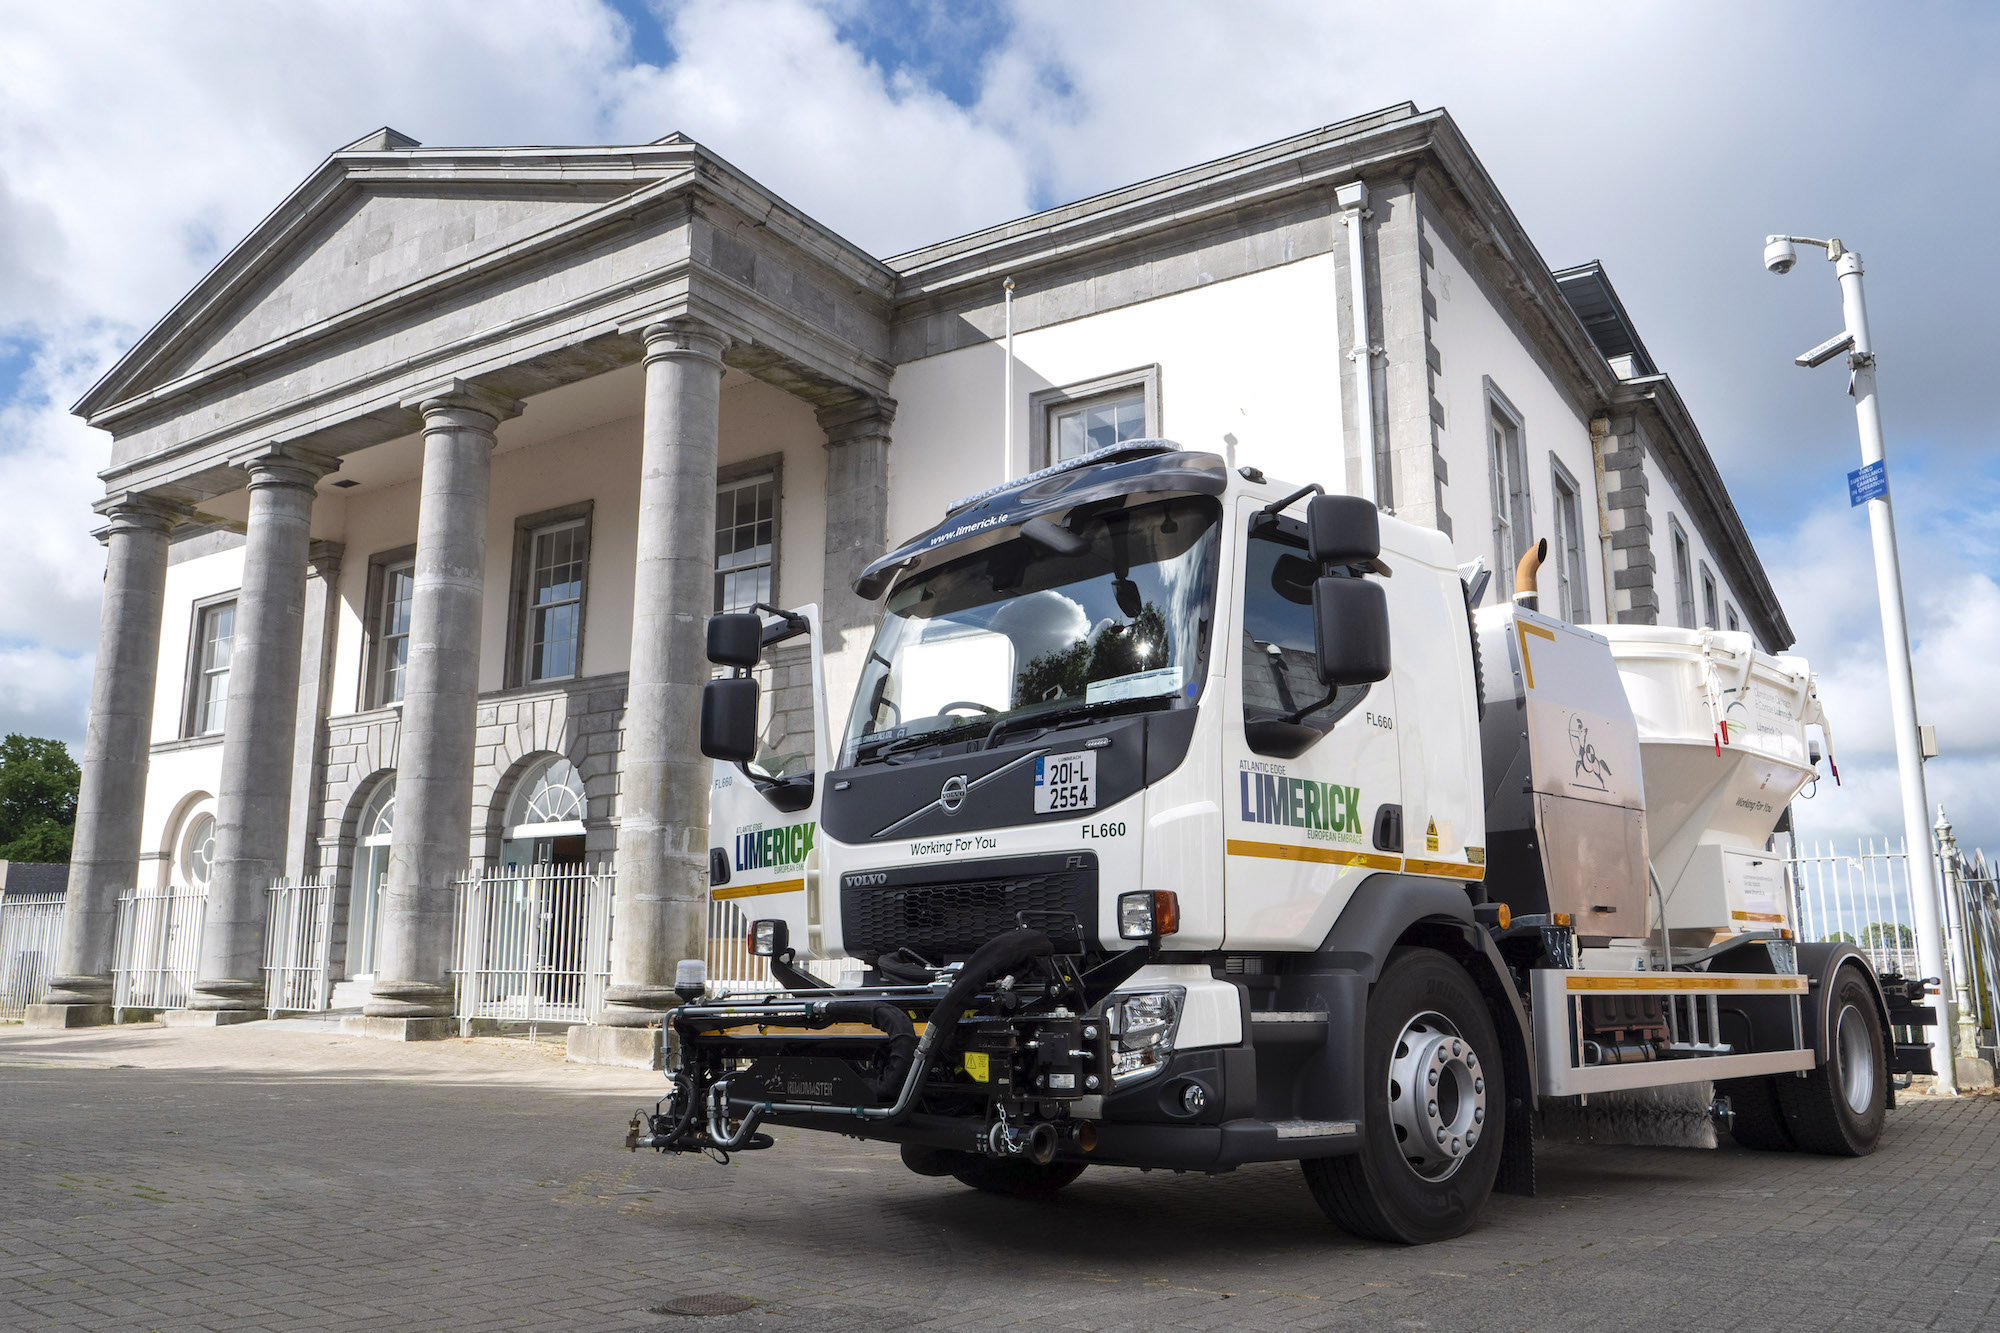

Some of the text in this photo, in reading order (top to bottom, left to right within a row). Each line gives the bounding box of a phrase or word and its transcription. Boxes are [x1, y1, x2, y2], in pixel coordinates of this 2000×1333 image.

[1856, 475, 1878, 488] CAMERAS
[930, 513, 1009, 546] www.limerick.ie
[1366, 712, 1393, 730] FL660
[1050, 761, 1089, 786] 201-L
[1239, 759, 1286, 775] ATLANTIC EDGE
[715, 776, 733, 789] FL660
[1035, 774, 1044, 782] IRL
[942, 791, 965, 799] VOLVO
[1050, 784, 1088, 809] 2554
[1240, 771, 1363, 834] LIMERICK
[1735, 796, 1774, 813] Working For You
[736, 822, 763, 834] ATLANTIC EDGE
[1082, 822, 1126, 839] FL660
[1307, 829, 1363, 845] EUROPEAN EMBRACE
[736, 821, 816, 872] LIMERICK
[910, 836, 997, 856] Working For You
[774, 863, 795, 875] EUROPEAN
[1066, 855, 1088, 869] FL
[845, 873, 887, 887] VOLVO
[787, 1081, 833, 1096] ROADMASTER
